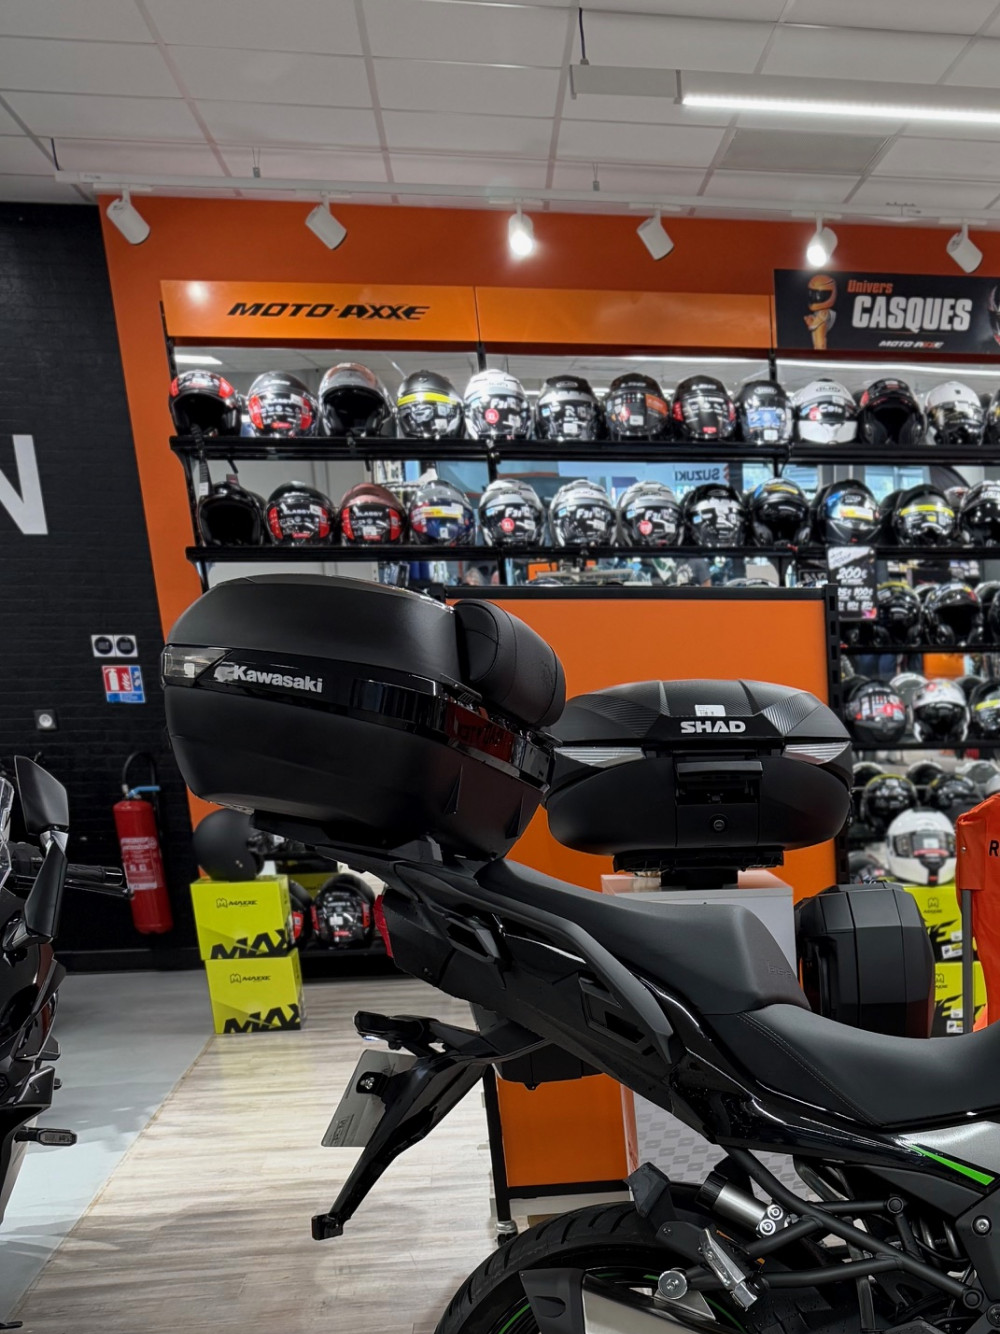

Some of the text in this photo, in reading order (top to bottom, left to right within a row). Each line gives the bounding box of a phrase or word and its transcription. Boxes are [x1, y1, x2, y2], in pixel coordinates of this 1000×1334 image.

[847, 280, 893, 294] Univers
[852, 295, 973, 334] CASQUES
[234, 665, 323, 693] Kawasaki
[680, 720, 746, 734] SHAD
